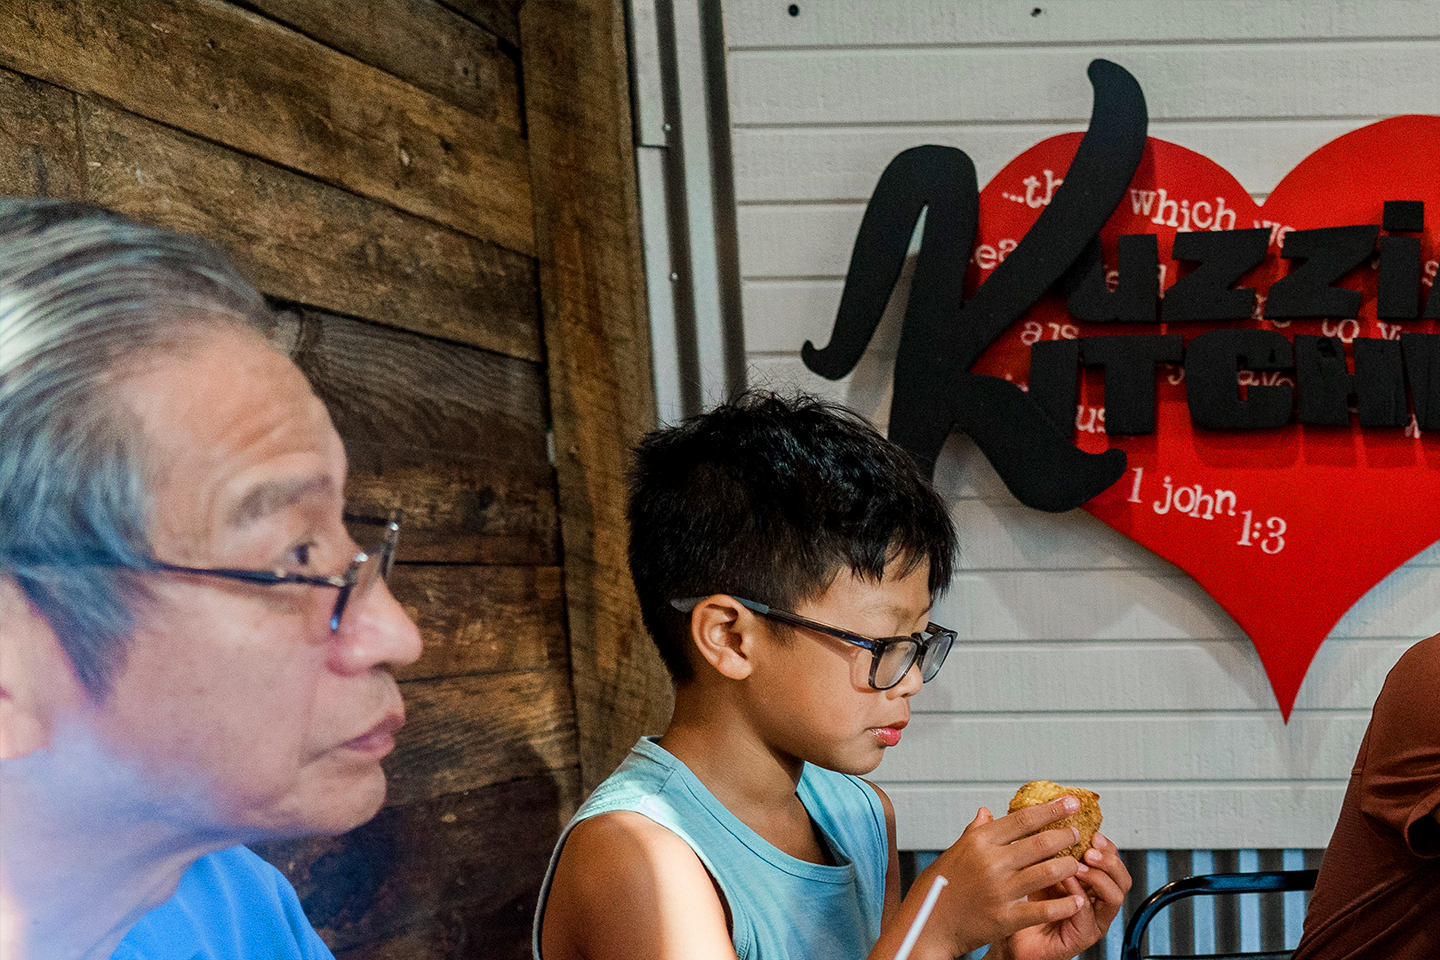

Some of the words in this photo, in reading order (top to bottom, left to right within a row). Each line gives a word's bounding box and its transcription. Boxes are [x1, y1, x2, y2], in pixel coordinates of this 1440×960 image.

[1130, 188, 1237, 232] which
[1153, 475, 1237, 520] john
[1237, 510, 1287, 554] 1:3
